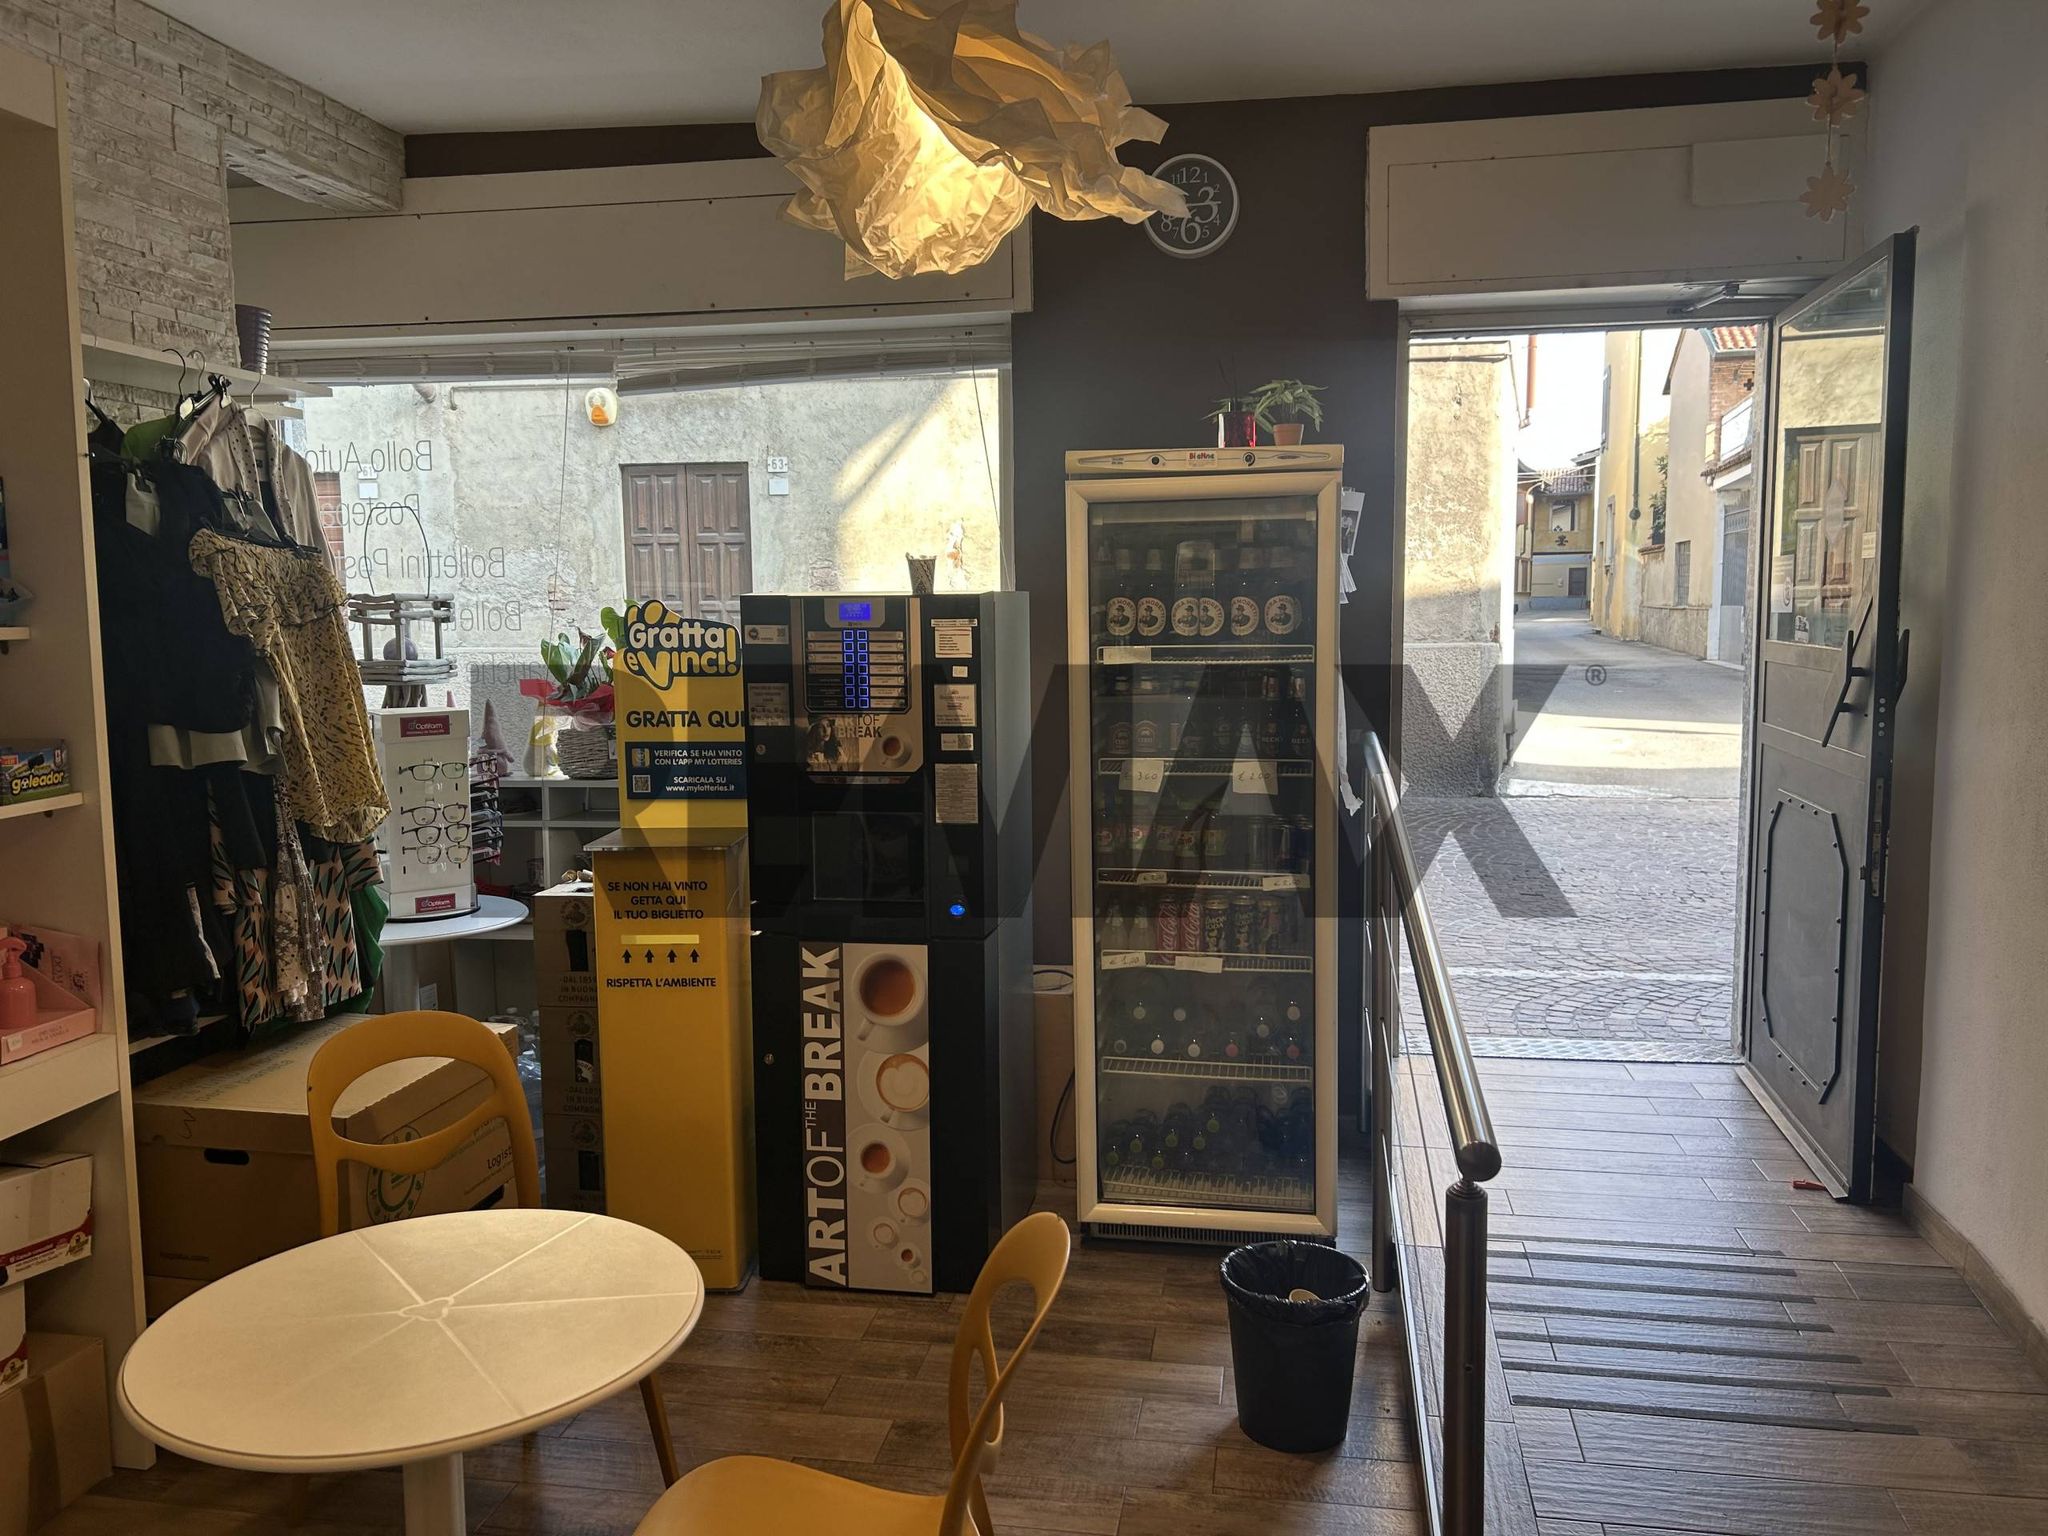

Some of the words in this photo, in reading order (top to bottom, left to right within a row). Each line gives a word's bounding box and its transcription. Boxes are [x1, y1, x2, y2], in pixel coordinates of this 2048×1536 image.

[1180, 166, 1201, 184] 12
[1204, 171, 1208, 184] 1
[1213, 184, 1220, 192] 2
[1195, 186, 1219, 223] 3
[1180, 217, 1201, 244] 6
[1202, 225, 1210, 238] 5
[771, 458, 784, 470] 63
[629, 621, 725, 648] Gratta
[627, 652, 639, 671] e
[637, 627, 737, 688] Vinci!
[626, 710, 702, 728] GRATTA
[708, 710, 746, 728] QUI
[837, 727, 882, 738] BREAK
[654, 749, 688, 757] VERIFICA
[690, 749, 699, 757] SE
[702, 749, 716, 757] HAI
[718, 749, 743, 757] VINTO
[11, 771, 64, 795] goleador
[673, 776, 714, 784] SCARICALA
[716, 776, 727, 784] SU
[665, 784, 735, 793] www.mylotteries.it
[608, 881, 620, 891] SE
[623, 881, 649, 891] NON
[652, 881, 672, 891] HAI
[674, 881, 708, 891] VINTO
[631, 895, 663, 905] GETTA
[666, 895, 686, 905] QUI
[614, 910, 622, 919] IL
[625, 910, 649, 919] TUO
[651, 910, 704, 919] BIGLIETTO
[606, 977, 653, 988] RISPETTA
[656, 977, 717, 988] L'AMBIENTE
[801, 946, 843, 1101] BREAK
[804, 1100, 817, 1128] THE
